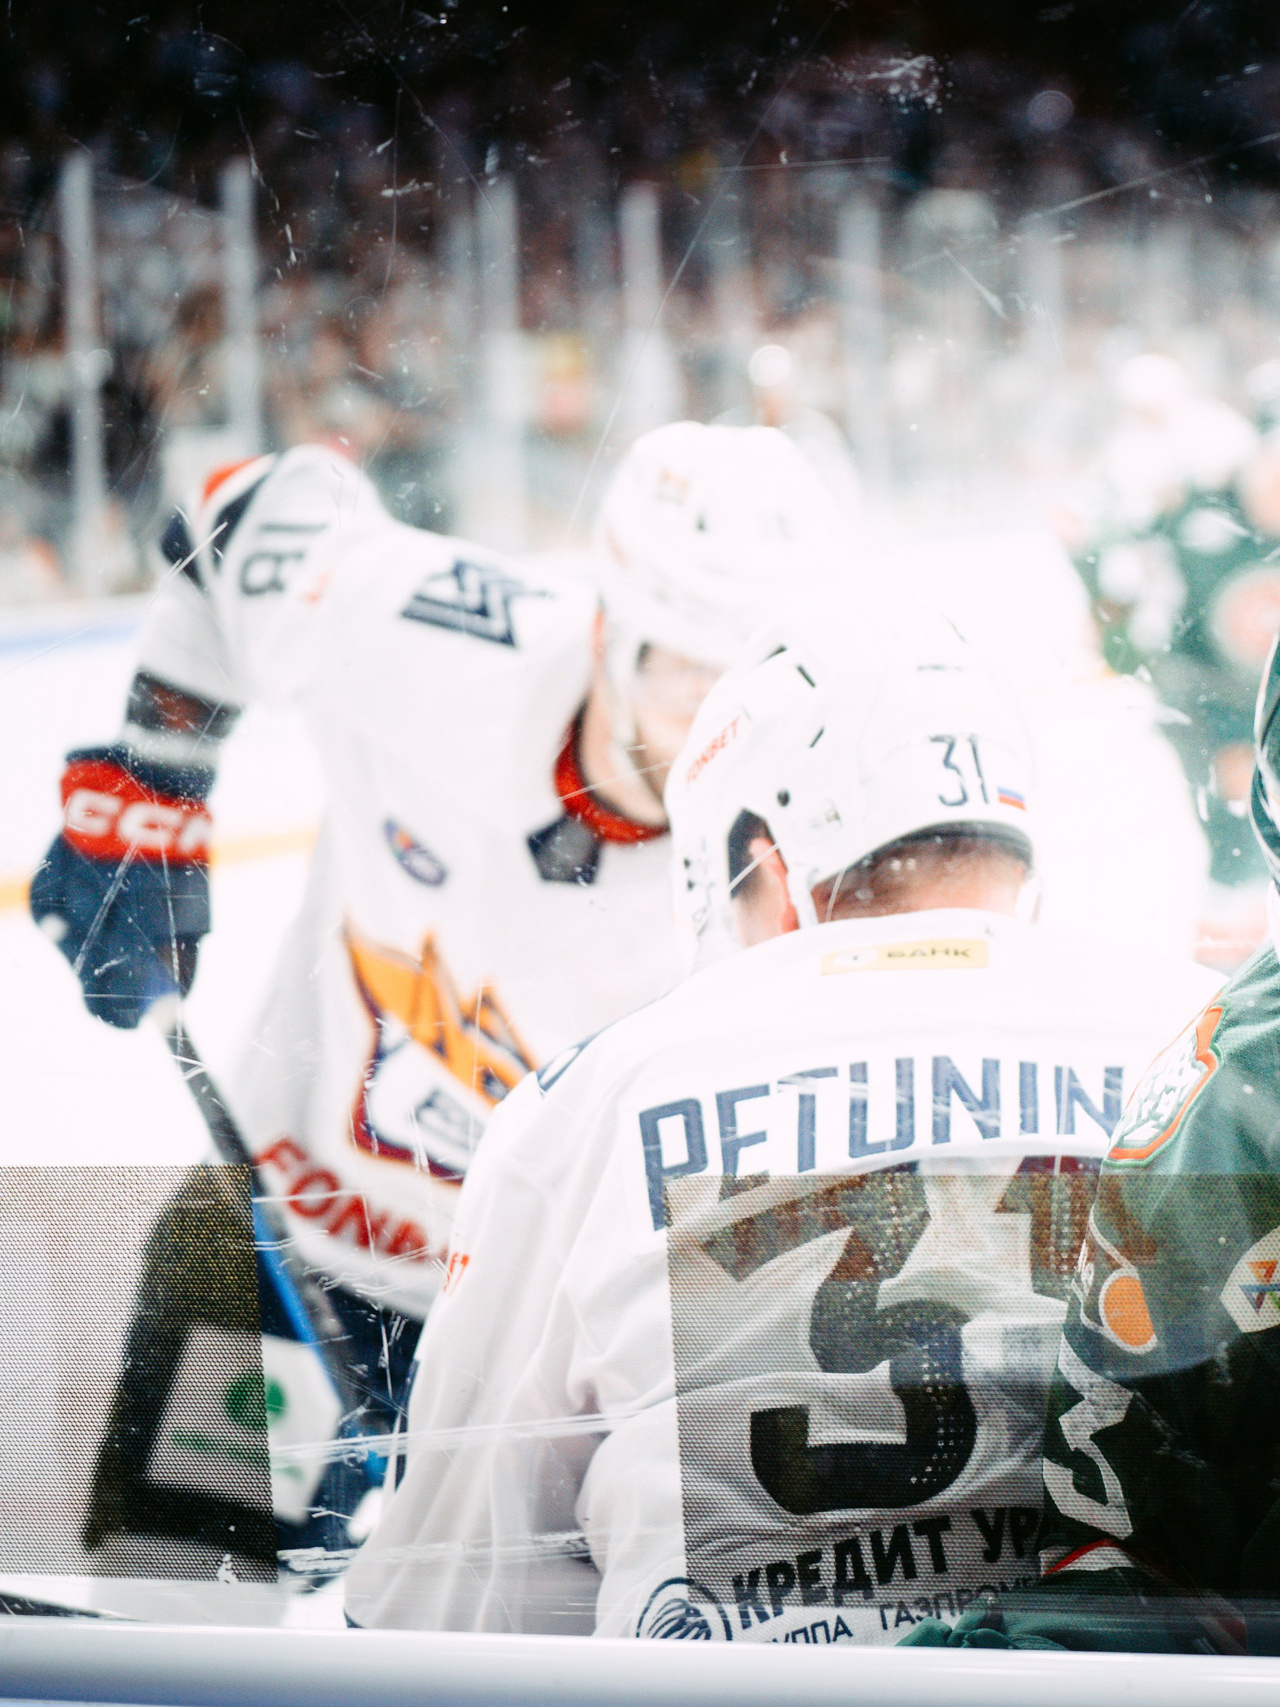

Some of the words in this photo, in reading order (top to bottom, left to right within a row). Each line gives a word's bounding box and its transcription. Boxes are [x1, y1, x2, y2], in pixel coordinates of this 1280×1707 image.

[928, 733, 990, 807] 31
[638, 1055, 1125, 1231] PETUNIN
[1042, 1332, 1134, 1541] 3
[731, 1513, 953, 1631] КРЕДИТ
